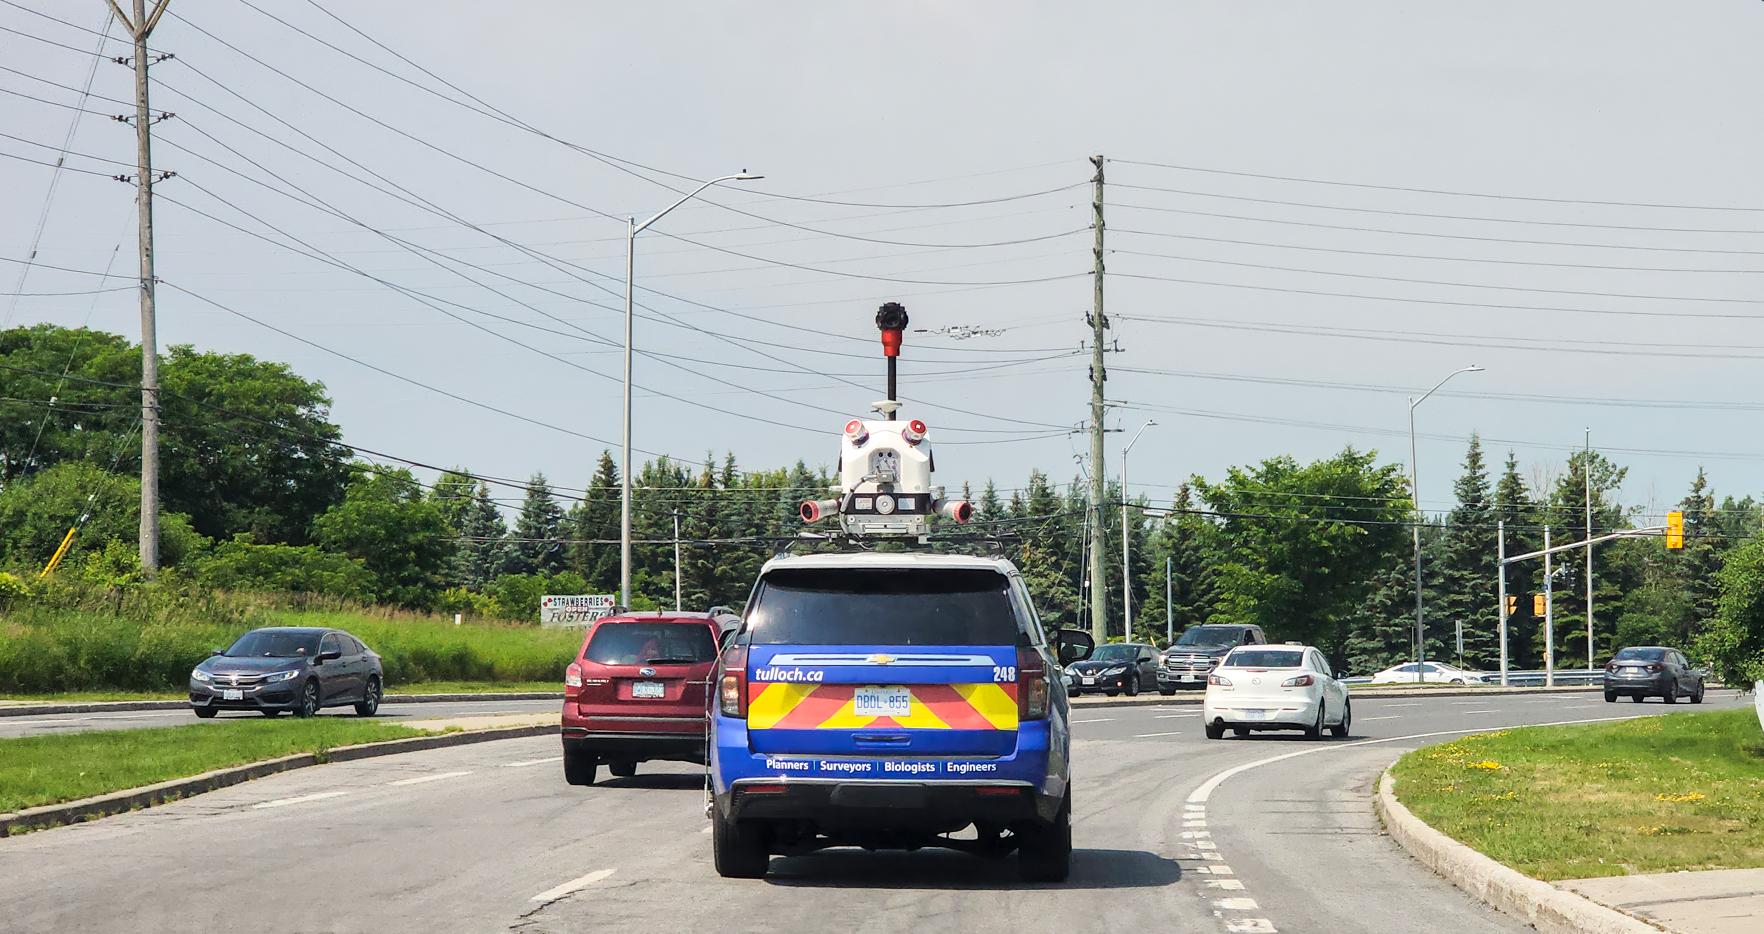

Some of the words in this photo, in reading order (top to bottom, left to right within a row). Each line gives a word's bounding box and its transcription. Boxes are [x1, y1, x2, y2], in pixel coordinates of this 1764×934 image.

[553, 597, 604, 606] STRAWBERRIES
[755, 667, 824, 682] tulloch.ca
[993, 666, 1016, 682] 248
[766, 759, 809, 770] Planners
[820, 760, 872, 773] Surveyors
[884, 761, 936, 773] Biologists
[947, 762, 997, 774] Engineers
